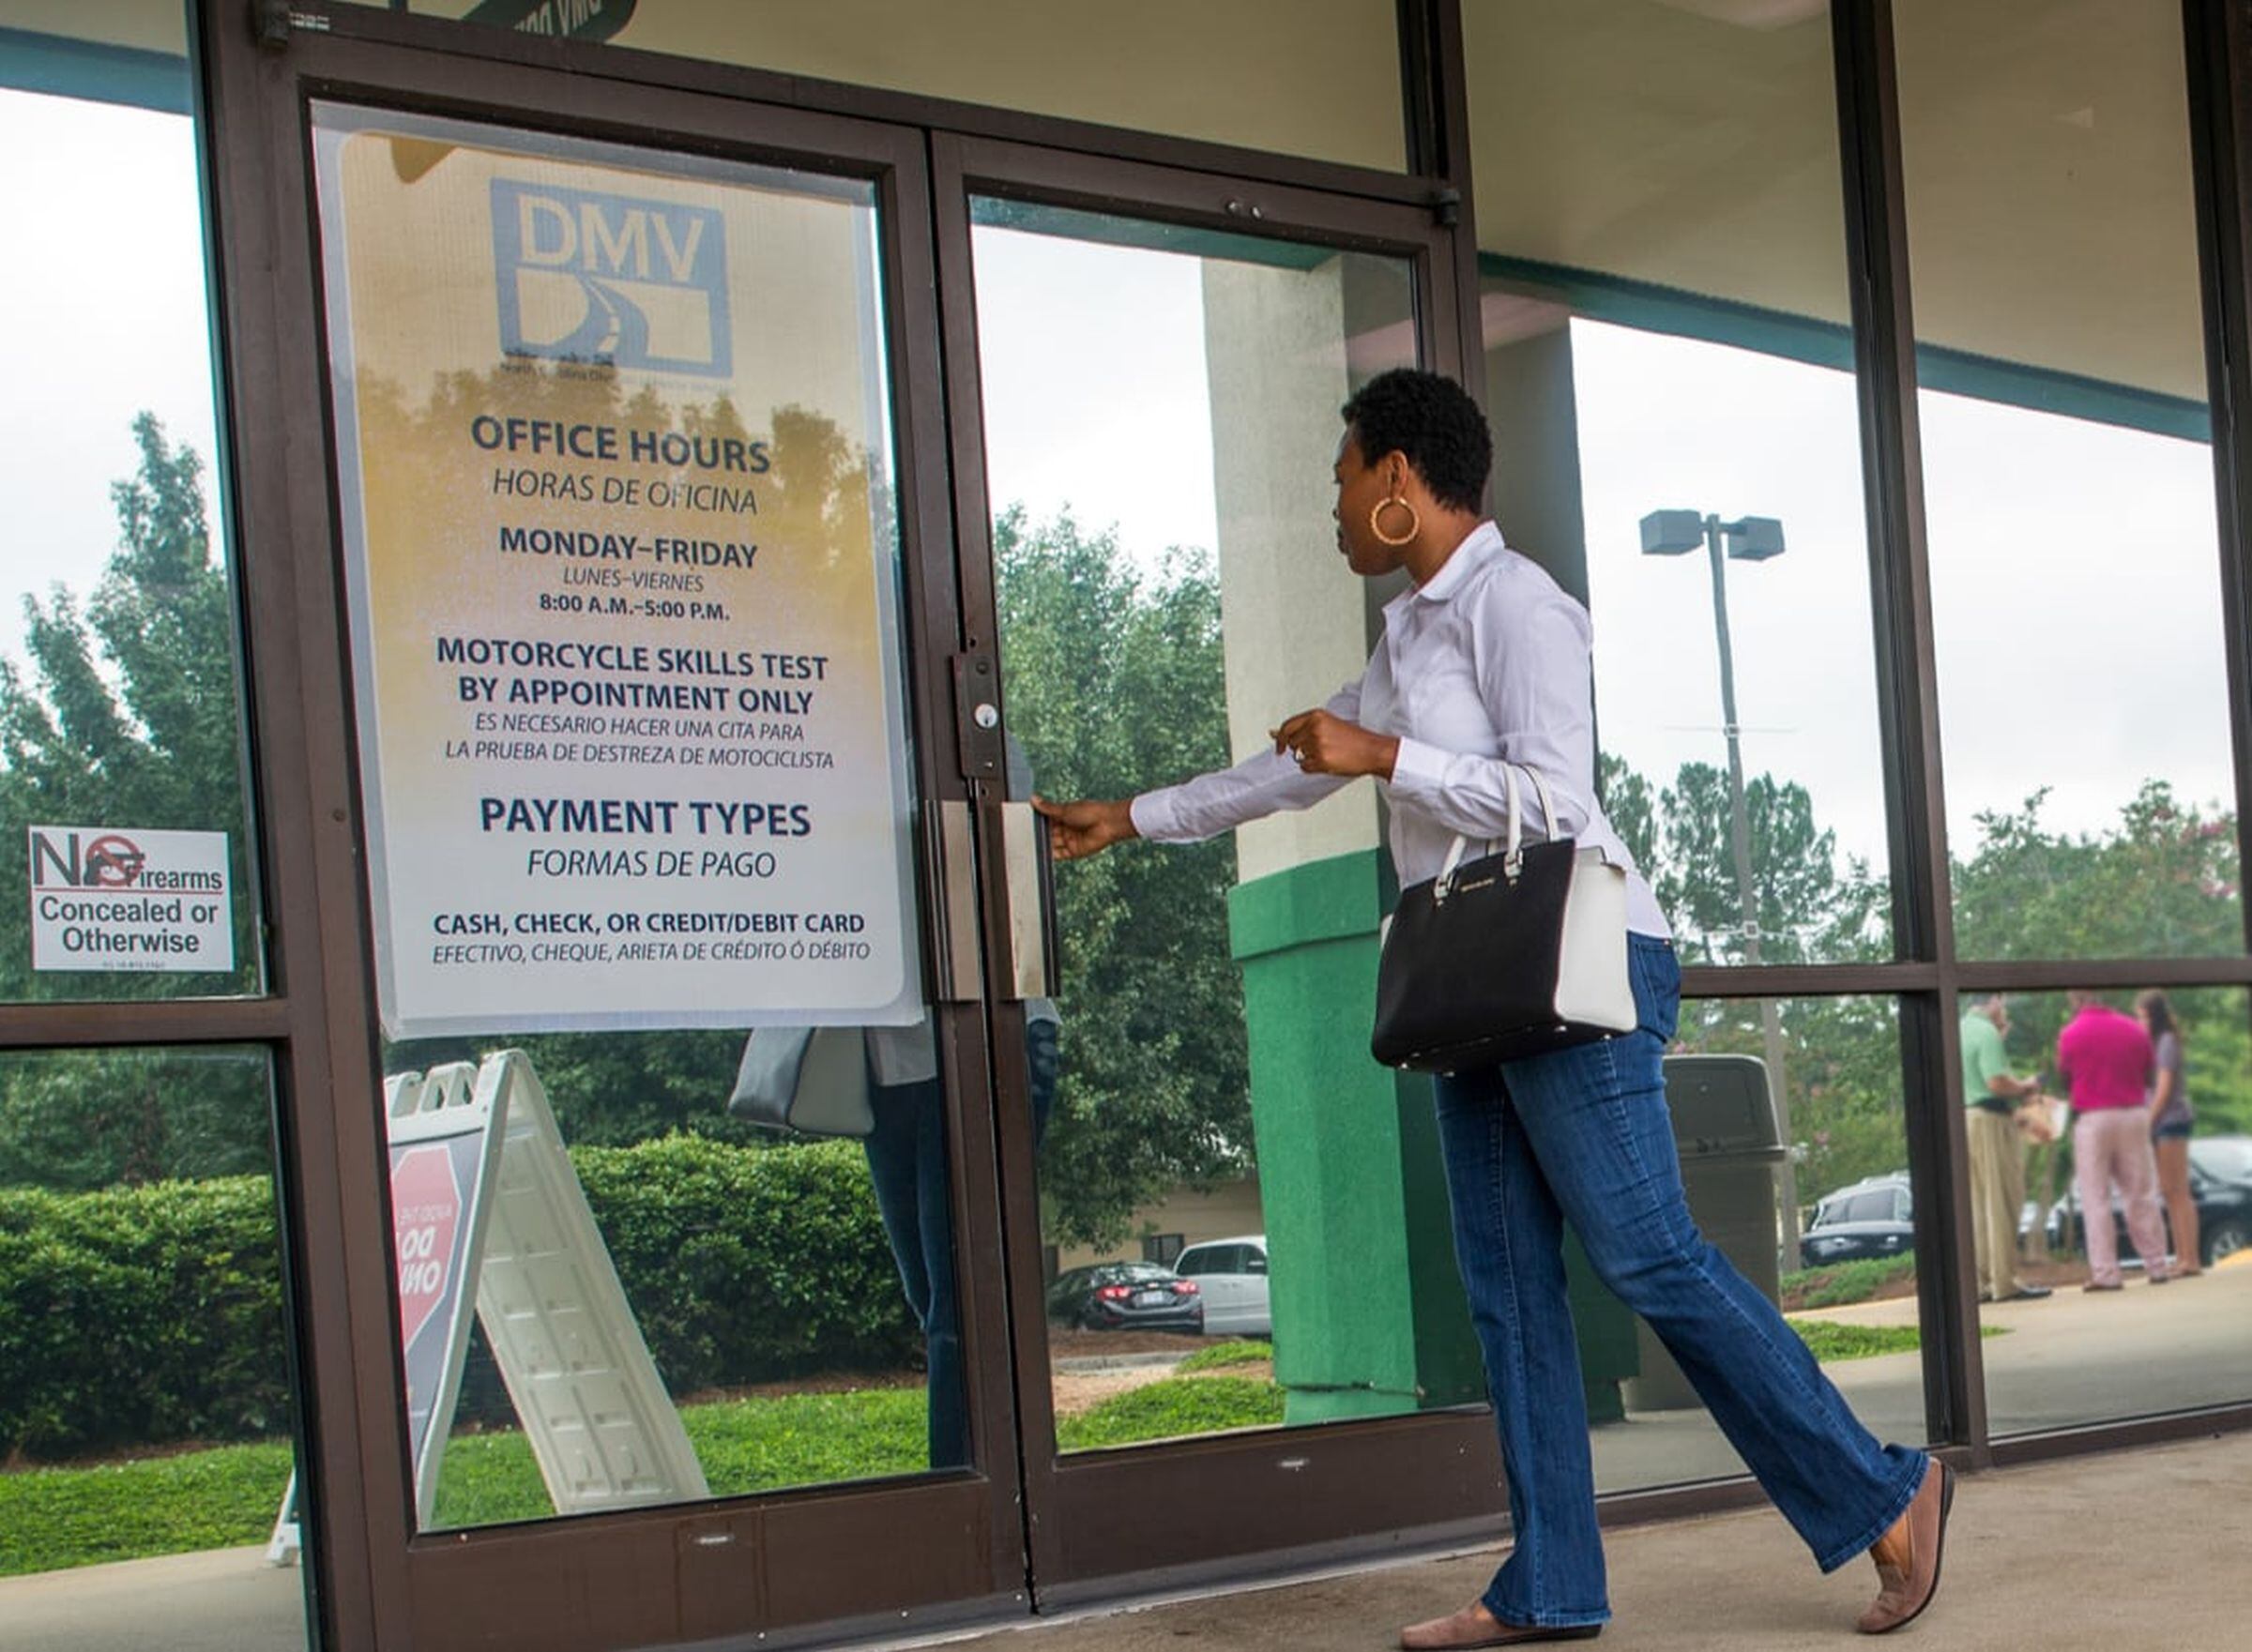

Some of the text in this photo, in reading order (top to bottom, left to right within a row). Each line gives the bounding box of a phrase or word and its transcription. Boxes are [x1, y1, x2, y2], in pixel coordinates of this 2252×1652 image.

[519, 193, 704, 281] DMV
[471, 416, 770, 473] OFFICE HOURS
[494, 469, 757, 515] HORAS DE OFICINA
[540, 594, 583, 611] 8:00
[691, 604, 730, 621] P.M.
[437, 638, 829, 680] MOTORCYCLE SKILLS TEST
[459, 676, 813, 715] BY APPOINTMENT ONLY
[476, 713, 804, 742] ES NECESARIO HACER UNA CITA PARA
[446, 740, 834, 769] LA PRUEBA DE DESTREZA DE MOTOCICLISTA
[480, 798, 812, 837] PAYMENT TYPES
[527, 850, 777, 878] FORMAS DE PAGO
[39, 896, 218, 923] Concealed or
[434, 913, 865, 936] CASH, CHECK, OR CREDIT/DEBIT CARD
[62, 927, 200, 953] Otherwise
[433, 944, 527, 964] EFECTIVO,
[531, 943, 613, 962] CHEQUE,
[683, 942, 706, 961] DE
[711, 940, 786, 961] CRÉDITO
[808, 940, 871, 961] DÉBITO
